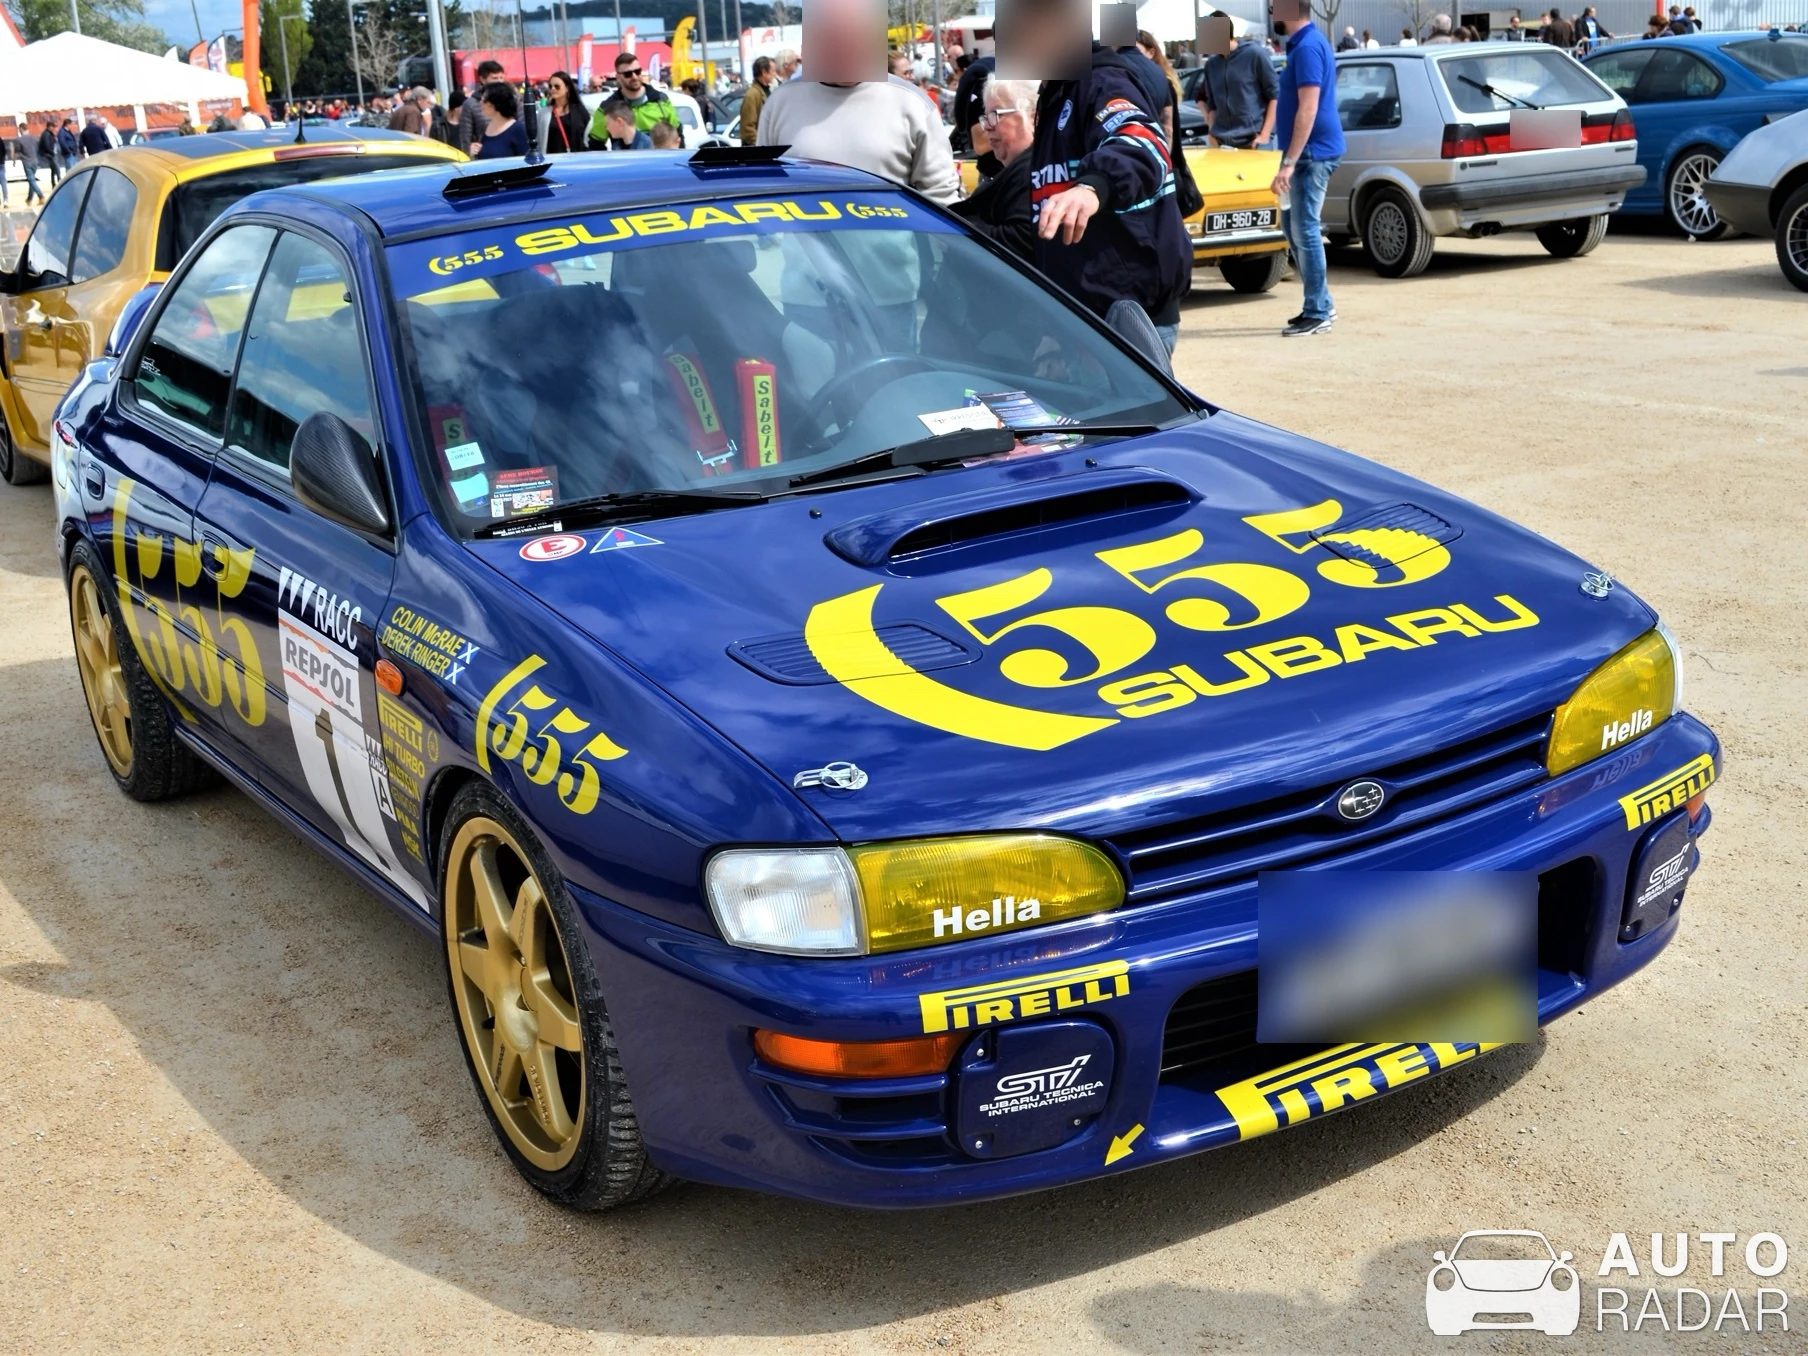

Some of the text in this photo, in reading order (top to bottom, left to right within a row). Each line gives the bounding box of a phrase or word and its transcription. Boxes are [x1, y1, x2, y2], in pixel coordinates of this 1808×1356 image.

[1031, 162, 1069, 189] RTIN
[515, 201, 841, 256] SUBARU
[757, 380, 772, 464] Sabelt
[541, 539, 568, 553] E
[314, 586, 362, 650] RACC
[391, 606, 466, 657] COLIN McRAE
[285, 637, 354, 707] REPSOL
[381, 626, 451, 678] DEREK RINGER
[1098, 595, 1540, 719] SUBARU
[378, 692, 423, 753] PIRELLI
[1601, 708, 1653, 750] Hella
[394, 740, 426, 779] TURBO
[378, 777, 393, 815] A
[1618, 753, 1716, 831] PIRELLI
[933, 896, 1041, 937] Hella
[1637, 883, 1664, 903] SUBARU
[919, 959, 1130, 1034] PIRELLI
[979, 1080, 1104, 1112] SUBARU TECNICA
[994, 1054, 1091, 1101] STI
[1214, 1043, 1506, 1141] PIREL
[988, 1090, 1096, 1117] INTERNATIONAL
